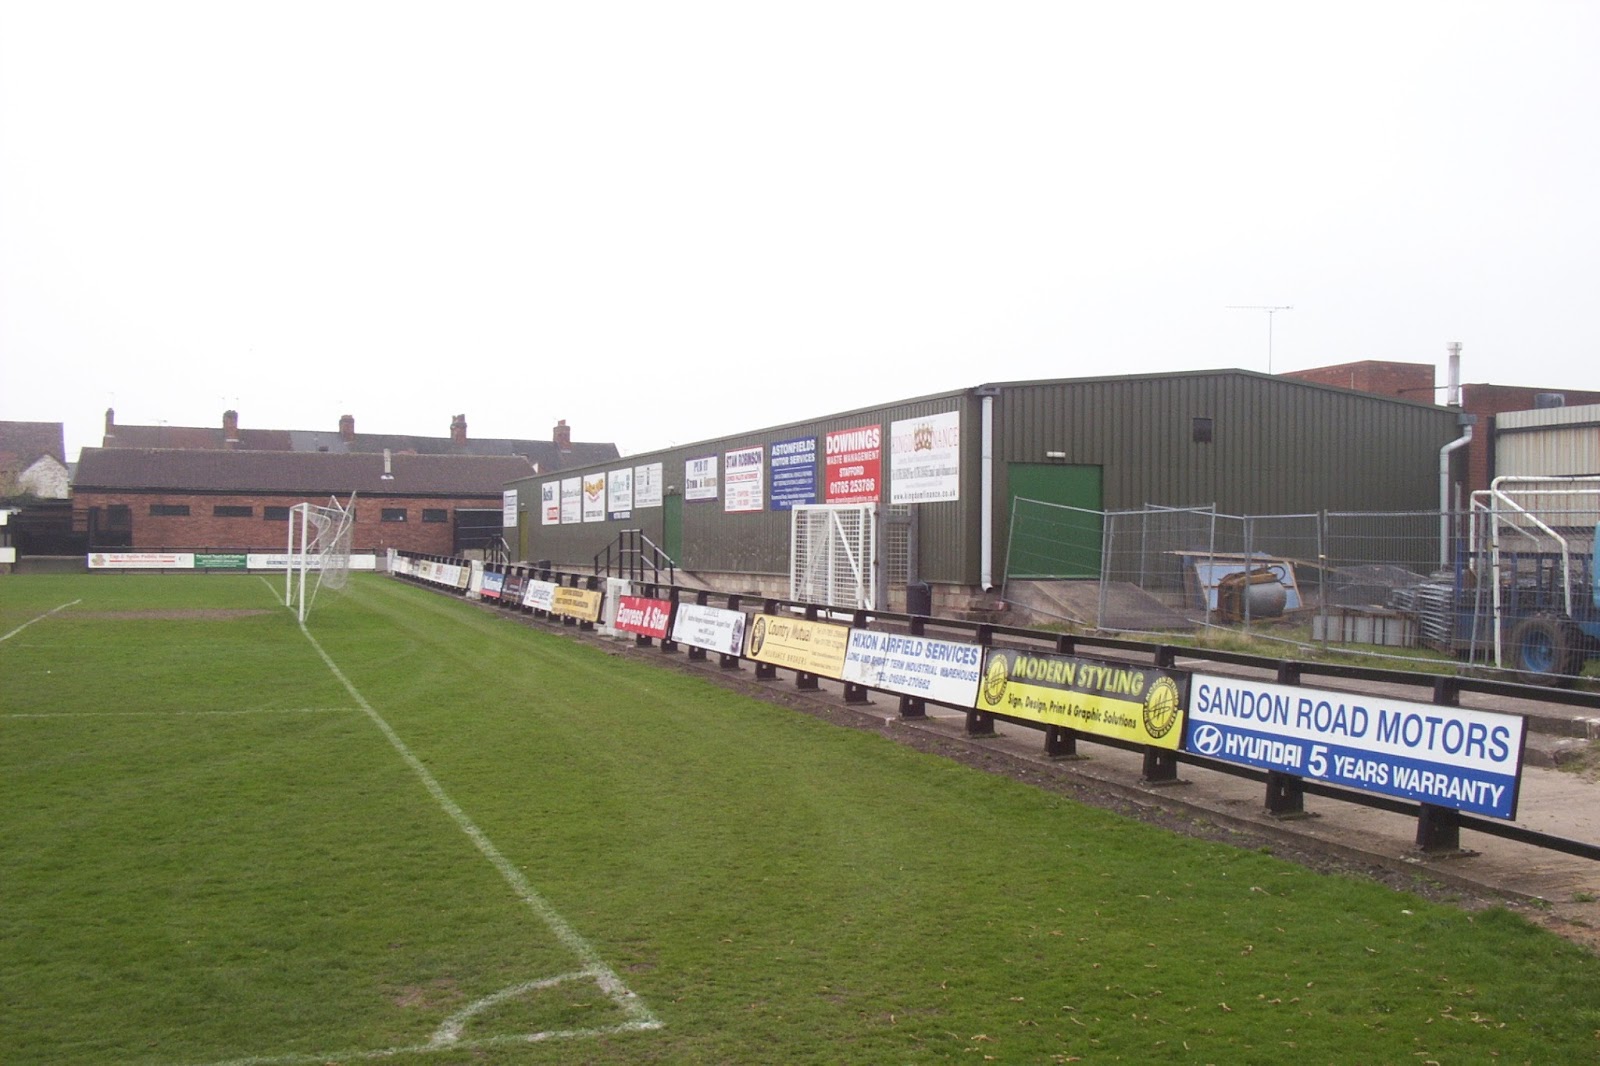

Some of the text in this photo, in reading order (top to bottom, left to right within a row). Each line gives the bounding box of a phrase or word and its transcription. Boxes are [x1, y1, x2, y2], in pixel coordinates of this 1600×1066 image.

[771, 439, 816, 456] ASTONFIELDS
[826, 428, 880, 454] DOWNINGS
[771, 453, 816, 467] MOTOR SERVICES
[826, 450, 880, 465] WASTE MANAGEMENT
[839, 465, 864, 478] STAFFORD
[829, 480, 849, 494] 01785
[617, 602, 644, 627] Express
[642, 606, 652, 627] &
[650, 607, 670, 630] Star
[768, 620, 791, 642] Country
[852, 633, 878, 650] HIXON
[880, 637, 923, 657] AIRFIELD
[925, 641, 978, 666] SERVICES
[860, 654, 871, 664] AND
[890, 659, 905, 670] TERM
[905, 661, 937, 675] INDUSTRIAL
[940, 667, 978, 682] WAREHOUSE
[1012, 656, 1145, 696] MODERN STYLING
[1050, 699, 1066, 713] Print
[1067, 705, 1073, 716] &
[1073, 706, 1101, 723] Graphic
[1103, 711, 1137, 729] Solutions
[1197, 684, 1510, 762] SANDON ROAD MOTORS
[1225, 732, 1505, 808] HYUNDAI 5 YEARS WARRANTY
